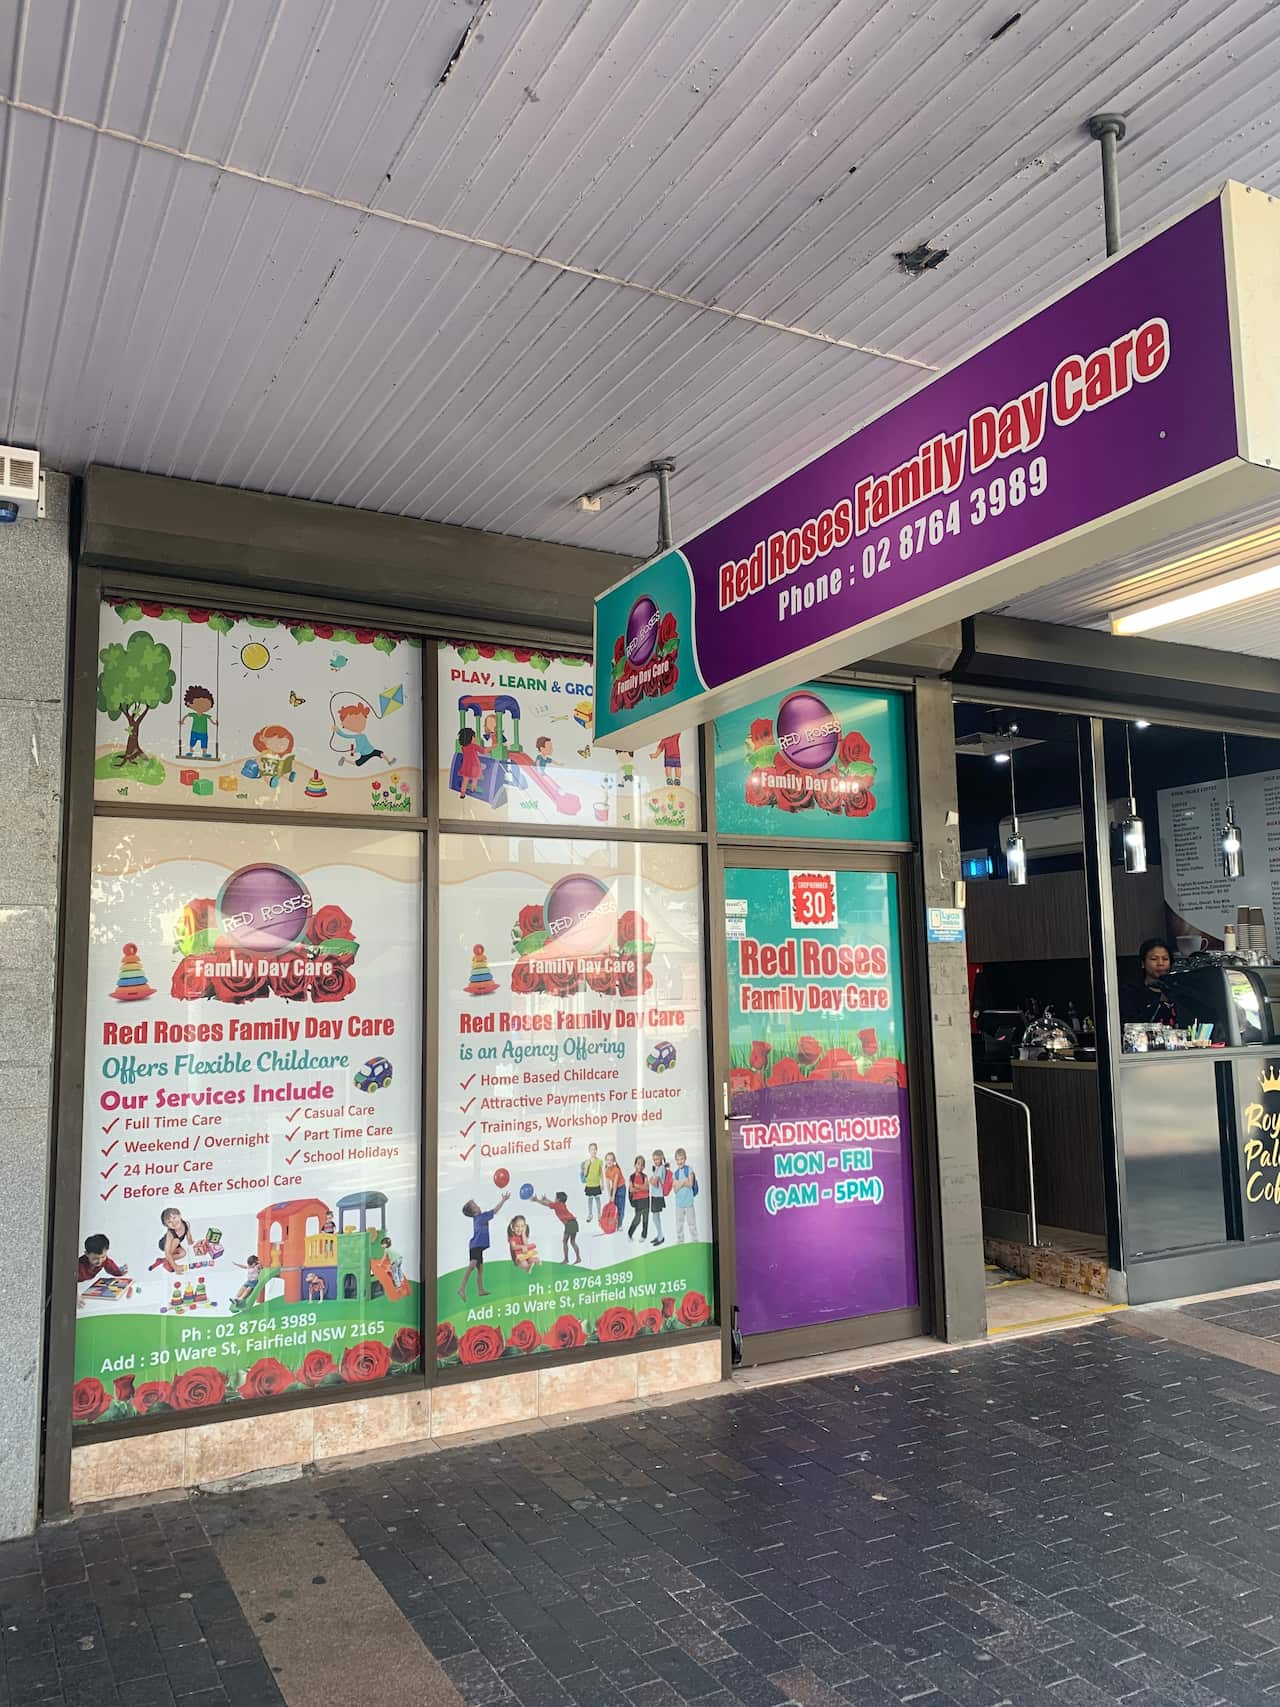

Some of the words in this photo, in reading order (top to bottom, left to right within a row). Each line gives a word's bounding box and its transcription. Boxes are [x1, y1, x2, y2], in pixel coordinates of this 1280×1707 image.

[718, 542, 765, 612] Red
[767, 499, 852, 585] Roses
[855, 428, 966, 537] Family
[970, 382, 1048, 474] Day
[1051, 316, 1170, 426] Care
[778, 565, 842, 622] Phone
[862, 537, 891, 579] 02
[899, 500, 961, 561] 8764
[970, 456, 1048, 526] 3989
[451, 669, 495, 687] PLAY,
[499, 675, 547, 691] LEARN
[551, 680, 561, 693] &
[618, 674, 638, 695] Family
[639, 668, 652, 684] Day
[652, 660, 669, 678] Care
[778, 732, 800, 750] RED
[806, 719, 842, 742] ROSES
[761, 772, 803, 794] Family
[805, 776, 829, 793] Day
[831, 776, 859, 793] Care
[223, 911, 253, 932] RED
[261, 894, 312, 922] ROSES
[802, 892, 826, 918] 30
[550, 916, 573, 936] RED
[195, 959, 253, 978] Family
[257, 959, 289, 977] Day
[293, 959, 333, 977] Care
[529, 959, 574, 975] Family
[577, 959, 600, 975] Day
[604, 959, 634, 973] Care
[739, 938, 796, 978] Red
[800, 940, 888, 979] Roses
[740, 984, 804, 1013] Family
[807, 984, 842, 1012] Day
[845, 985, 890, 1010] Care
[103, 1020, 148, 1046] Red
[154, 1019, 224, 1043] Roses
[229, 1017, 300, 1042] Family
[304, 1017, 343, 1040] Day
[348, 1015, 395, 1038] Care
[460, 1012, 494, 1034] Red
[500, 1012, 552, 1032] Roses
[556, 1010, 612, 1032] Family
[615, 1009, 646, 1028] Day
[648, 1009, 685, 1027] Care
[460, 1044, 473, 1060] is
[478, 1047, 497, 1060] an
[502, 1040, 558, 1063] Agency
[562, 1036, 626, 1058] Offering
[102, 1056, 168, 1085] Offers
[175, 1053, 251, 1076] Flexible
[256, 1049, 350, 1073] Childcare
[481, 1073, 519, 1086] Home
[523, 1071, 560, 1084] Based
[564, 1068, 619, 1082] Childcare
[100, 1089, 148, 1111] Our
[156, 1086, 245, 1108] Services
[253, 1080, 334, 1103] Include
[480, 1095, 543, 1110] Attractive
[546, 1091, 605, 1106] Payments
[609, 1090, 628, 1101] For
[631, 1087, 681, 1100] Educator
[124, 1117, 150, 1131] Full
[154, 1116, 188, 1130] Time
[192, 1113, 222, 1127] Care
[304, 1105, 344, 1119] Casual
[347, 1104, 375, 1118] Care
[480, 1119, 542, 1134] Trainings,
[546, 1114, 608, 1130] Workshop
[611, 1109, 662, 1123] Provided
[124, 1137, 190, 1153] Weekend
[204, 1132, 270, 1149] Overnight
[304, 1128, 329, 1141] Part
[333, 1127, 363, 1139] Time
[366, 1125, 392, 1138] Care
[740, 1120, 833, 1149] TRADING
[835, 1115, 900, 1141] HOURS
[304, 1149, 345, 1164] School
[348, 1146, 399, 1161] Holidays
[480, 1141, 540, 1158] Qualified
[544, 1137, 572, 1150] Staff
[1244, 1139, 1280, 1171] Pal
[124, 1163, 141, 1177] 24
[145, 1161, 179, 1176] Hour
[183, 1159, 214, 1173] Care
[775, 1151, 824, 1177] MON
[840, 1148, 872, 1172] FRI
[123, 1183, 170, 1200] Before
[174, 1181, 185, 1195] &
[189, 1180, 224, 1195] After
[226, 1176, 270, 1191] School
[273, 1174, 302, 1187] Care
[765, 1182, 819, 1215] (9AM
[834, 1176, 884, 1204] 5PM)
[528, 1284, 544, 1296] Ph
[554, 1280, 569, 1292] 02
[573, 1276, 602, 1290] 8764
[605, 1271, 633, 1286] 3989
[467, 1306, 493, 1322] Add
[505, 1303, 520, 1316] 30
[523, 1299, 556, 1313] Ware
[559, 1295, 575, 1309] St,
[579, 1288, 626, 1305] Fairfield
[629, 1283, 657, 1297] NSW
[660, 1279, 687, 1292] 2165
[181, 1328, 201, 1343] Ph
[216, 1323, 237, 1339] 02
[239, 1318, 276, 1336] 8764
[280, 1313, 317, 1330] 3989
[101, 1355, 134, 1374] Add
[150, 1351, 170, 1366] 30
[174, 1346, 217, 1363] Ware
[220, 1341, 241, 1358] St,
[246, 1333, 307, 1353] Fairfield
[311, 1328, 345, 1345] NSW
[350, 1321, 385, 1338] 2165
